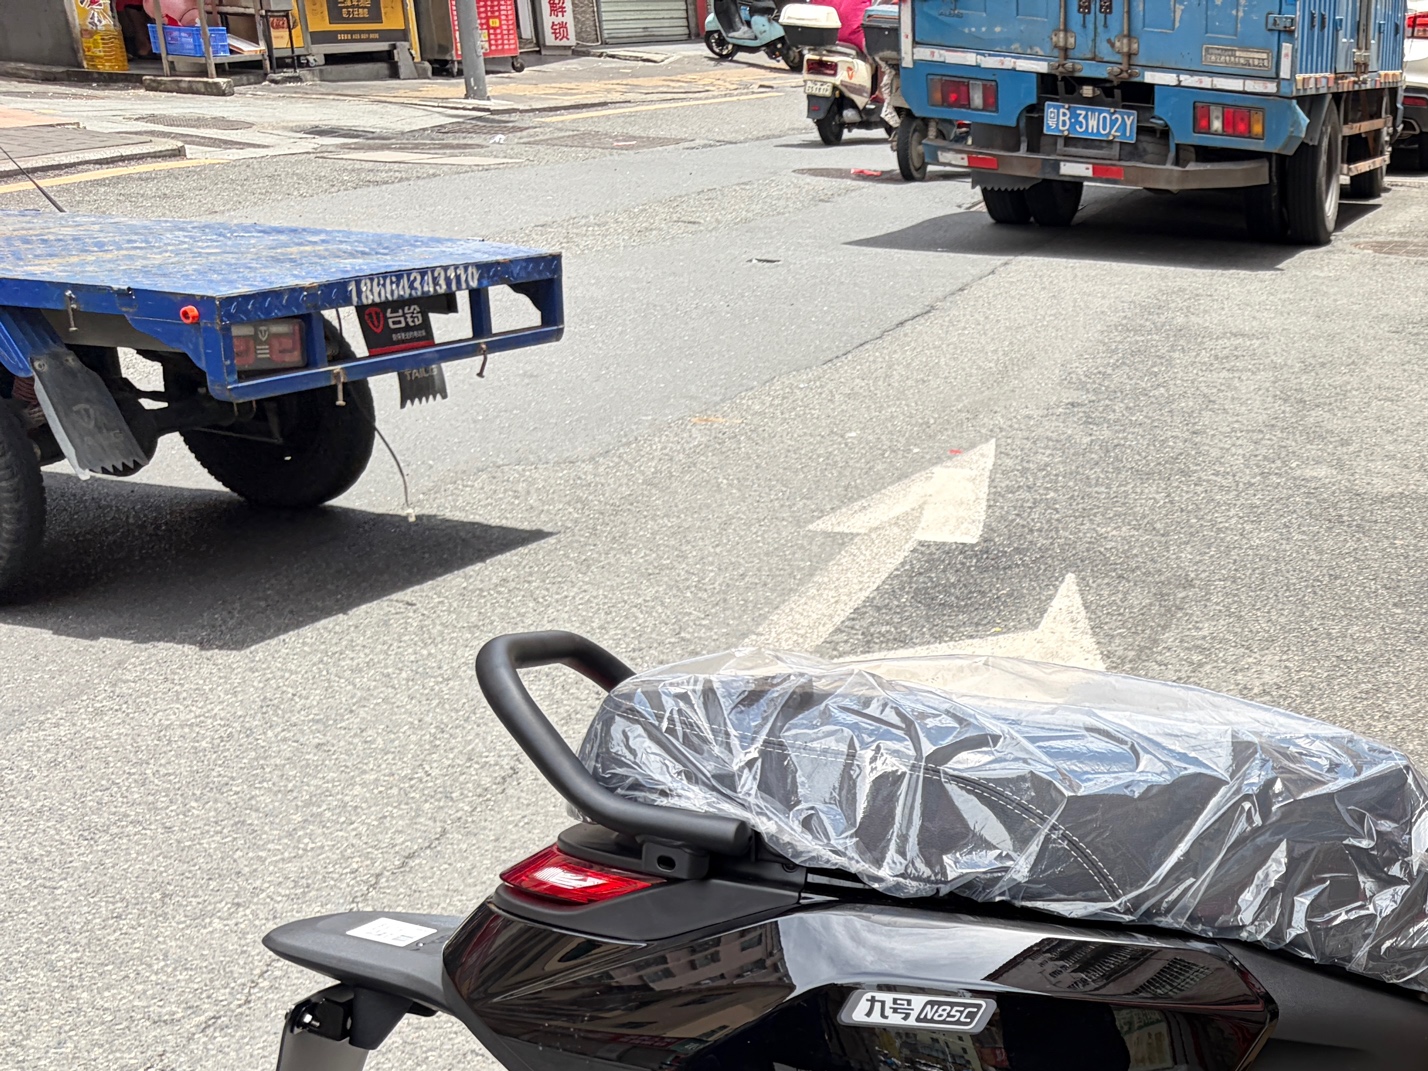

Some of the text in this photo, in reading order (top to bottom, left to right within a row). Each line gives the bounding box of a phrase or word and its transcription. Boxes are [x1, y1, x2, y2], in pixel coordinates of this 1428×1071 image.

[547, 0, 570, 42] 解锁
[347, 264, 480, 306] 18664343110
[386, 304, 423, 329] 台铃
[864, 995, 978, 1023] 九号 N85C
